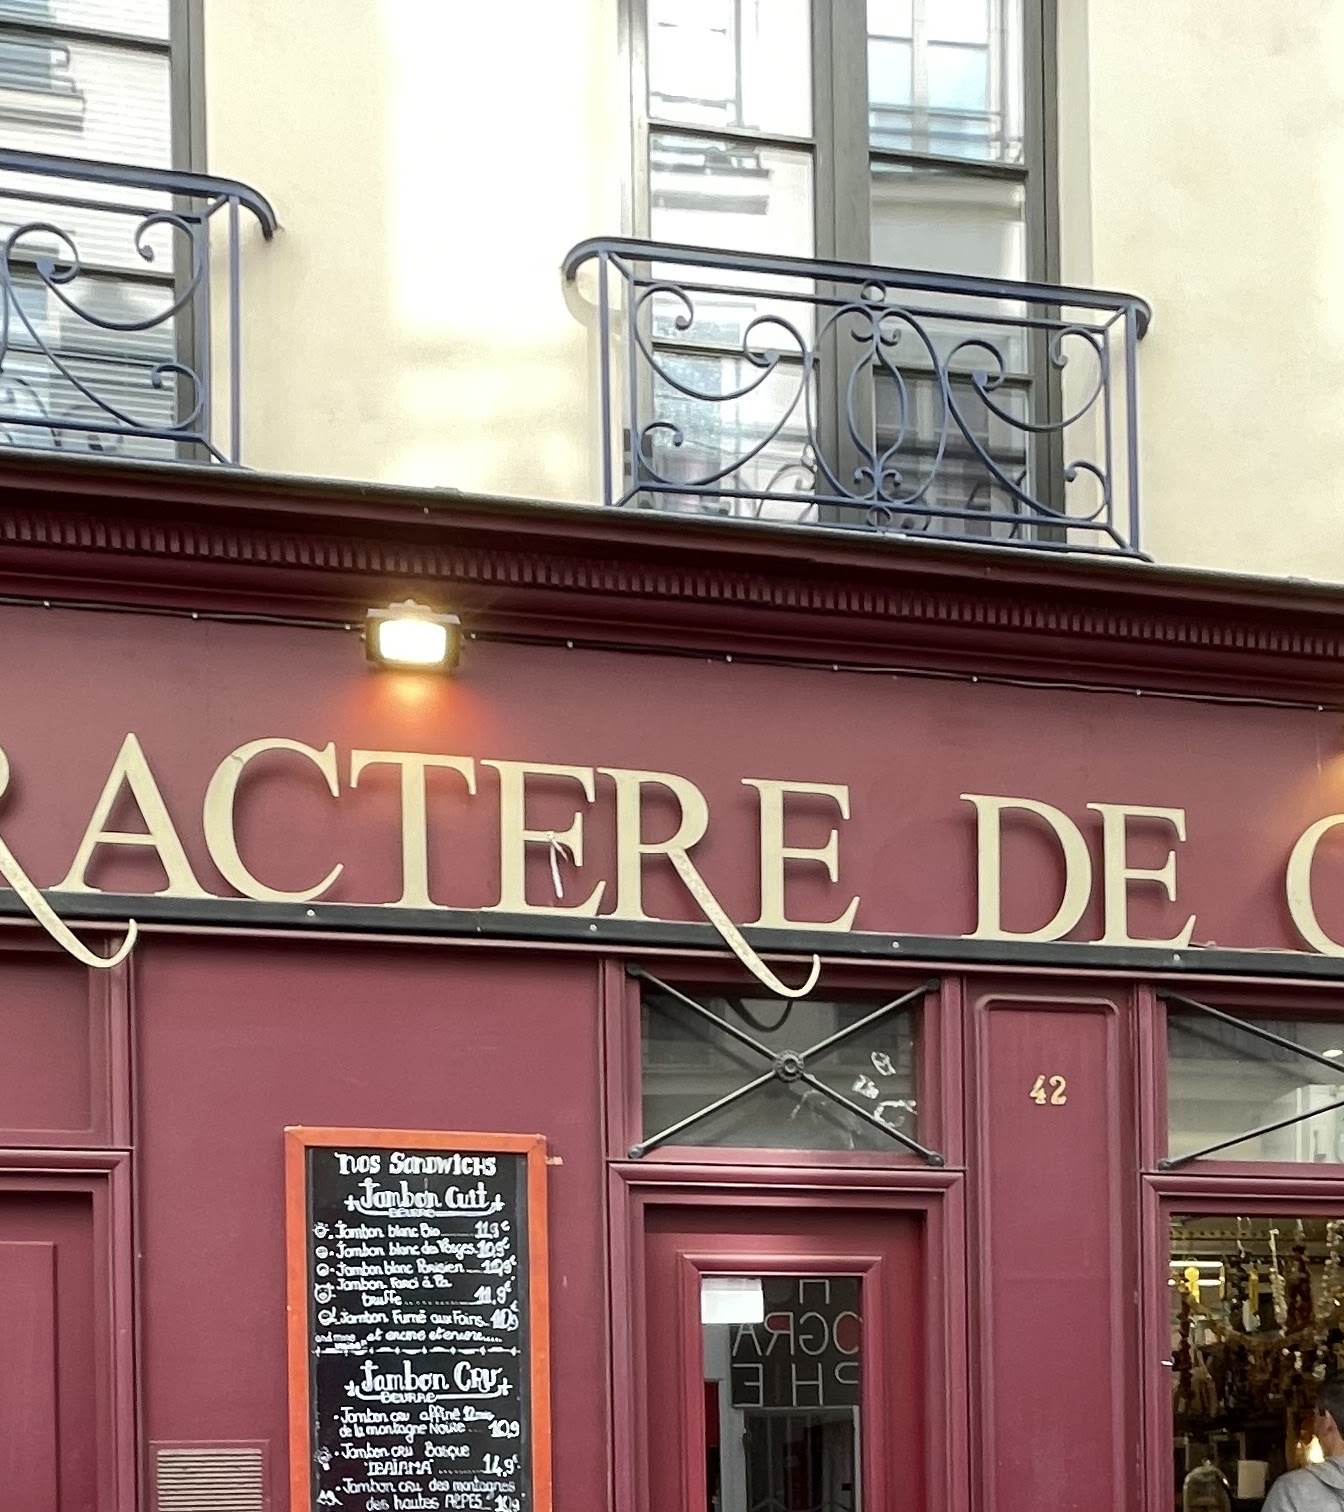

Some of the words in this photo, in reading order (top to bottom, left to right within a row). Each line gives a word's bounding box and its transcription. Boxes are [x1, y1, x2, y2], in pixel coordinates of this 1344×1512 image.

[961, 793, 1196, 949] DE
[1029, 1075, 1067, 1105] 42
[358, 1177, 442, 1209] Jambon
[445, 1181, 490, 1209] Cuit
[335, 1220, 385, 1239] Jambon
[387, 1224, 419, 1238] blanc
[420, 1223, 441, 1238] Bio
[336, 1240, 385, 1259] Jambon
[389, 1241, 420, 1256] blanc
[335, 1261, 383, 1276] Jambon
[384, 1261, 414, 1275] blanc
[335, 1277, 387, 1291] Jambon
[340, 1308, 390, 1325] Jambon
[360, 1360, 450, 1392] Jambon
[340, 1406, 389, 1423] Jambon
[366, 1422, 428, 1444] montagne
[341, 1442, 389, 1460] Jambon
[341, 1478, 396, 1494] Jambon
[393, 1494, 440, 1510] hautes
